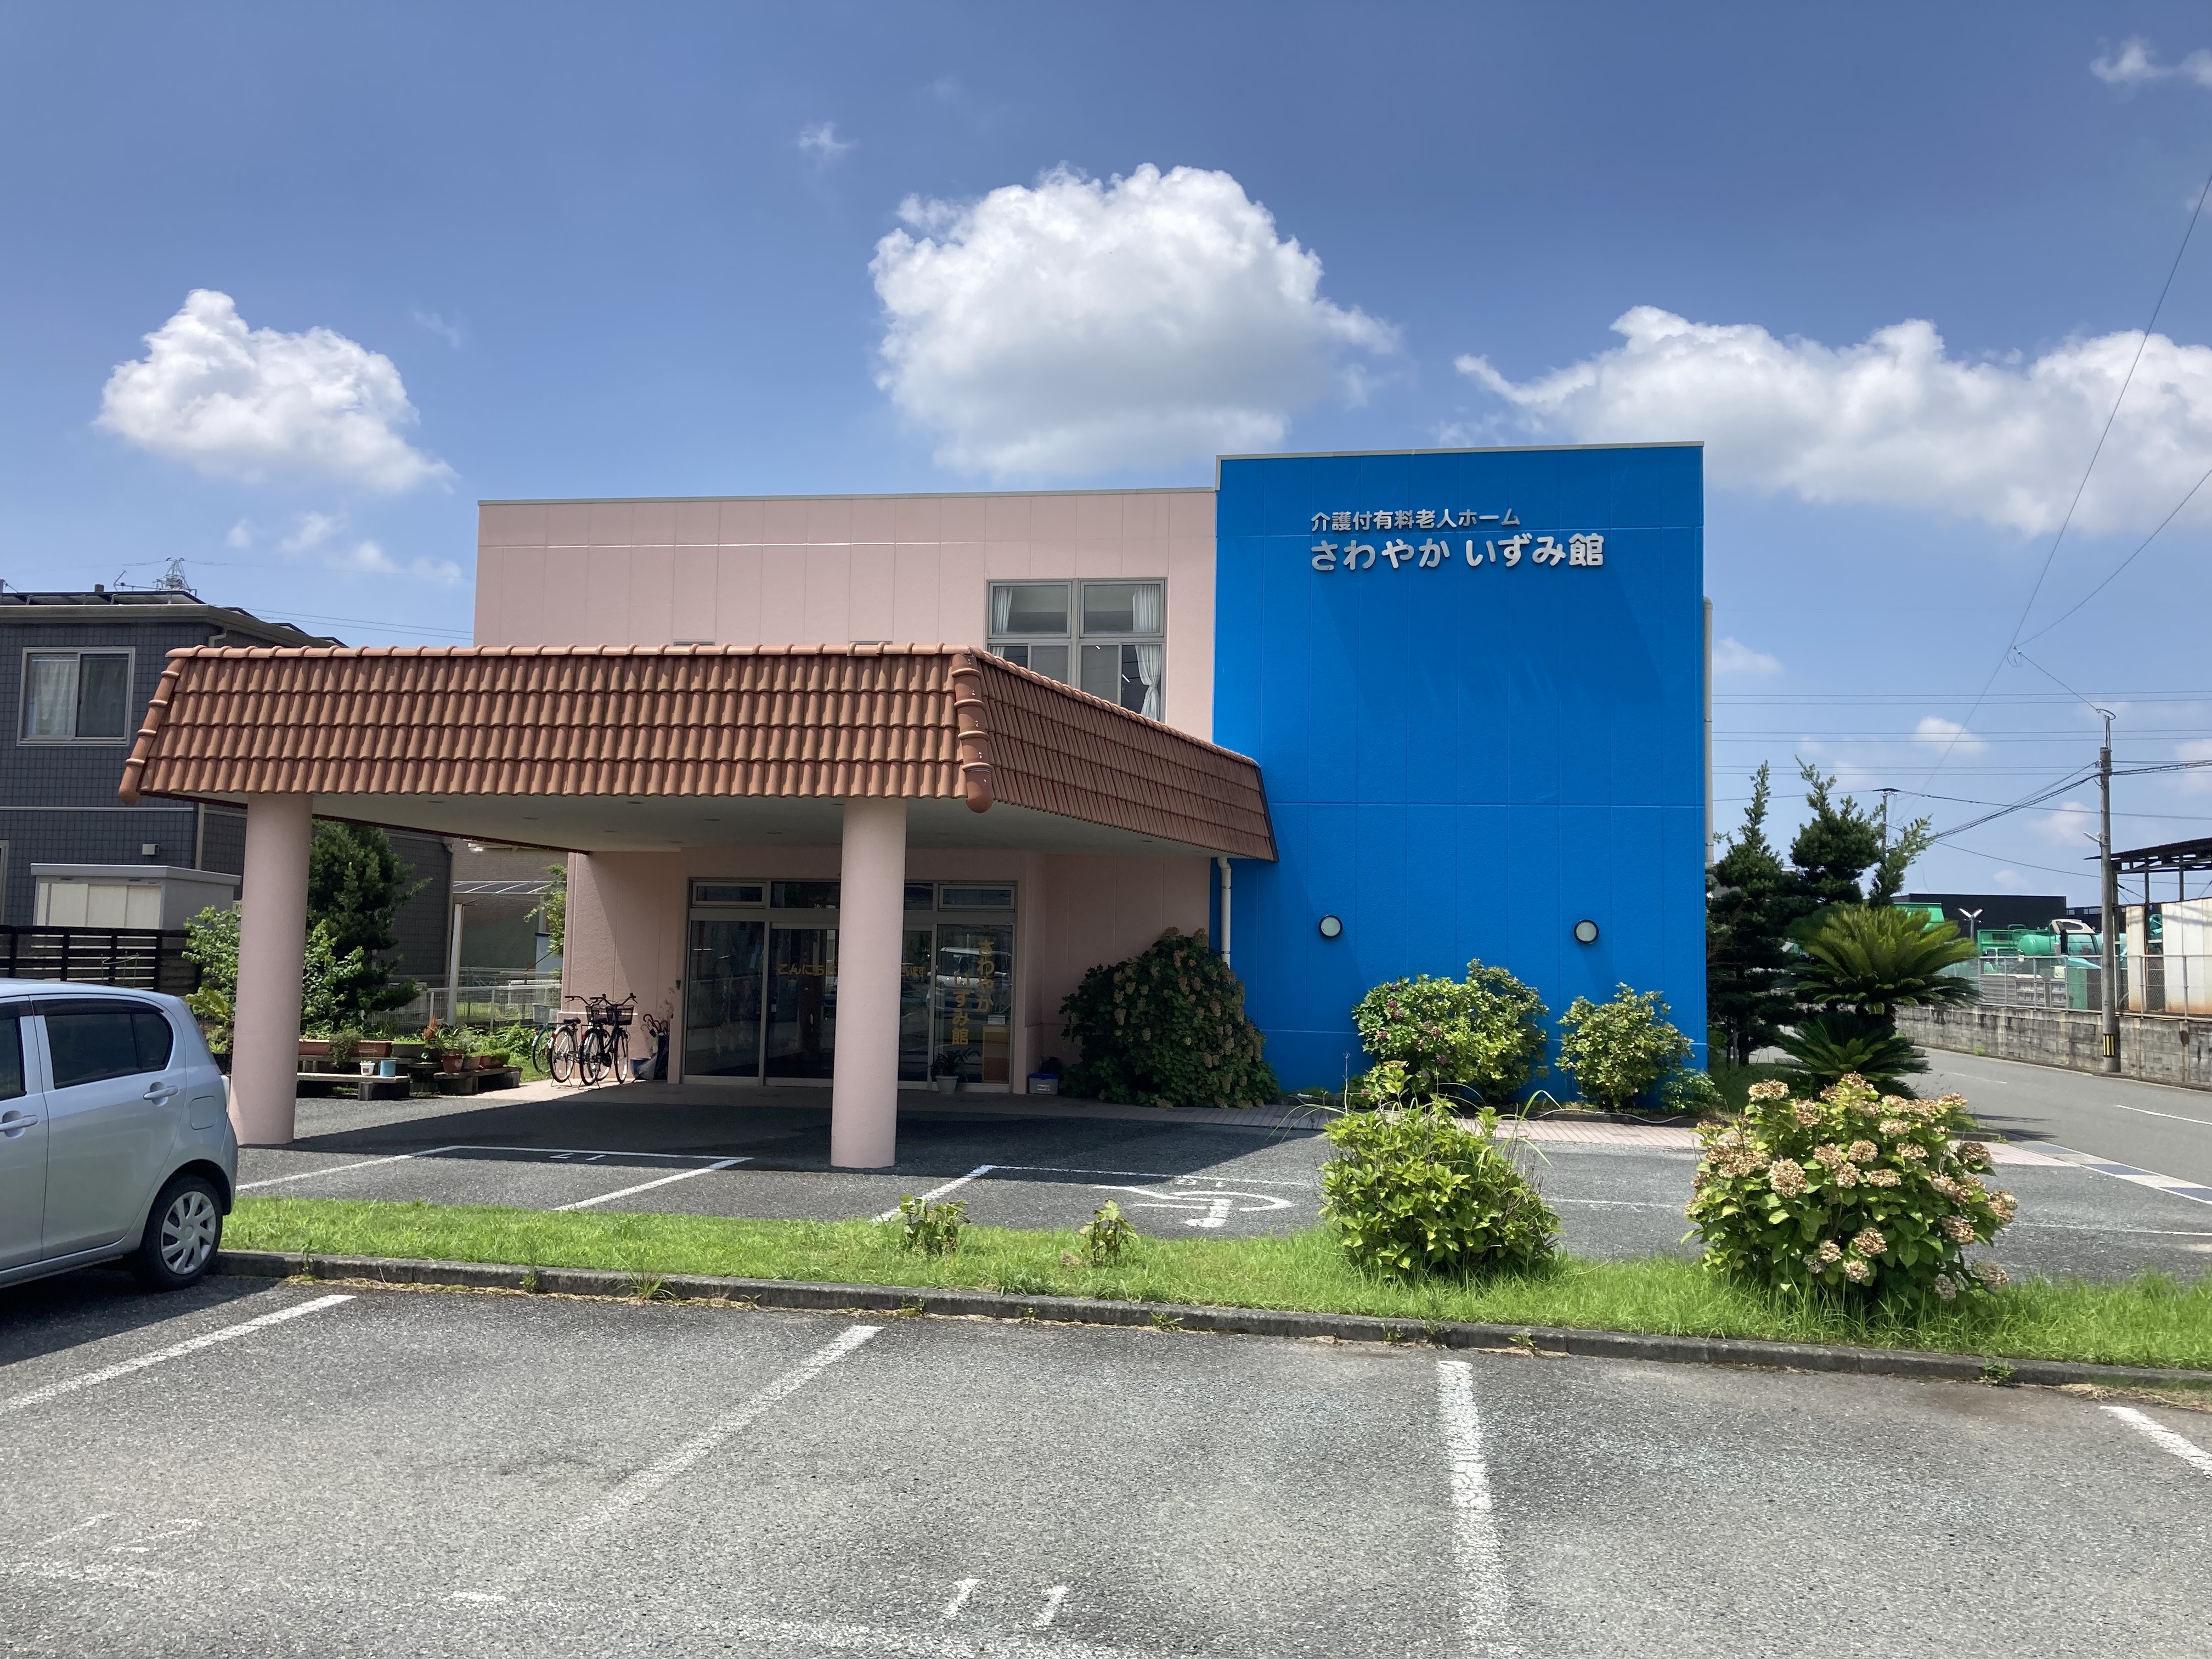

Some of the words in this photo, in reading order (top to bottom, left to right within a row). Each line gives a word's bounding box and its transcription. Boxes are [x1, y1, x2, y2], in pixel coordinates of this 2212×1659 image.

[1311, 509, 1520, 532] 介護付有料老人ホーム
[1311, 539, 1451, 571] さわやか
[1466, 533, 1604, 567] いずみ館
[978, 940, 994, 1013] さわやか
